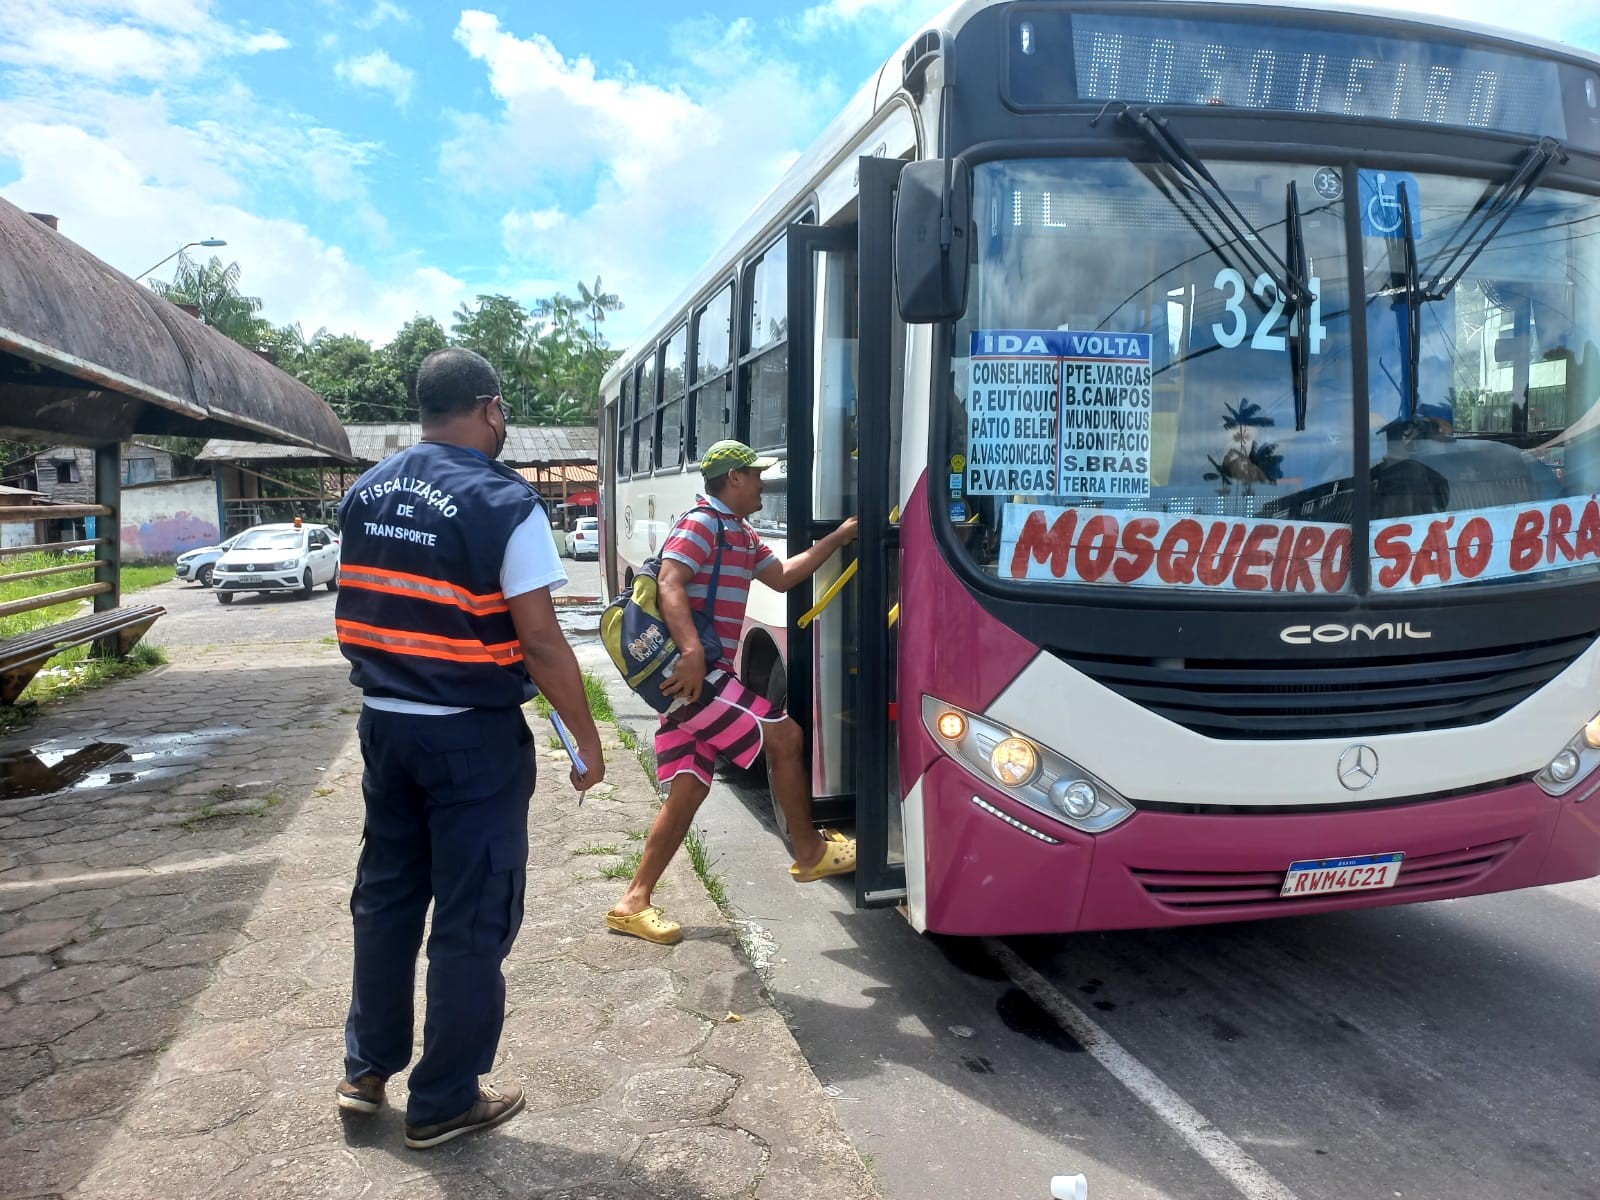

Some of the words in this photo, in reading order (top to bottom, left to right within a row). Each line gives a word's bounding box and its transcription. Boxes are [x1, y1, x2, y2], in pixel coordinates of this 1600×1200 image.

[1212, 267, 1327, 355] 324
[984, 335, 1049, 354] IDA
[1073, 336, 1142, 356] VOLTA
[973, 362, 1059, 385] CONSELHEIRO
[1066, 364, 1150, 386] PTE.VARGAS
[972, 390, 983, 411] P.
[987, 385, 1058, 413] EUTÍQUIO
[1066, 387, 1150, 408] B.CAMPOS
[972, 413, 1010, 438] PÁTIO
[1014, 413, 1057, 439] BELÉM
[1066, 410, 1149, 430] MUNDURUCUS
[1064, 428, 1149, 451] J.BONIFÁCIO
[970, 444, 1057, 464] A.VASCONCELOS
[970, 469, 1056, 491] P.VARGAS
[1063, 476, 1106, 493] TERRA
[1110, 477, 1149, 494] FIRME
[359, 477, 458, 518] FISCALIZAÇÃO
[396, 503, 415, 518] DE
[364, 522, 438, 546] TRANSPORTE
[1373, 516, 1494, 589] SÃO
[1509, 492, 1600, 572] BRÁ
[1010, 509, 1354, 593] MOSQUEIRO
[1279, 621, 1433, 645] COMIL
